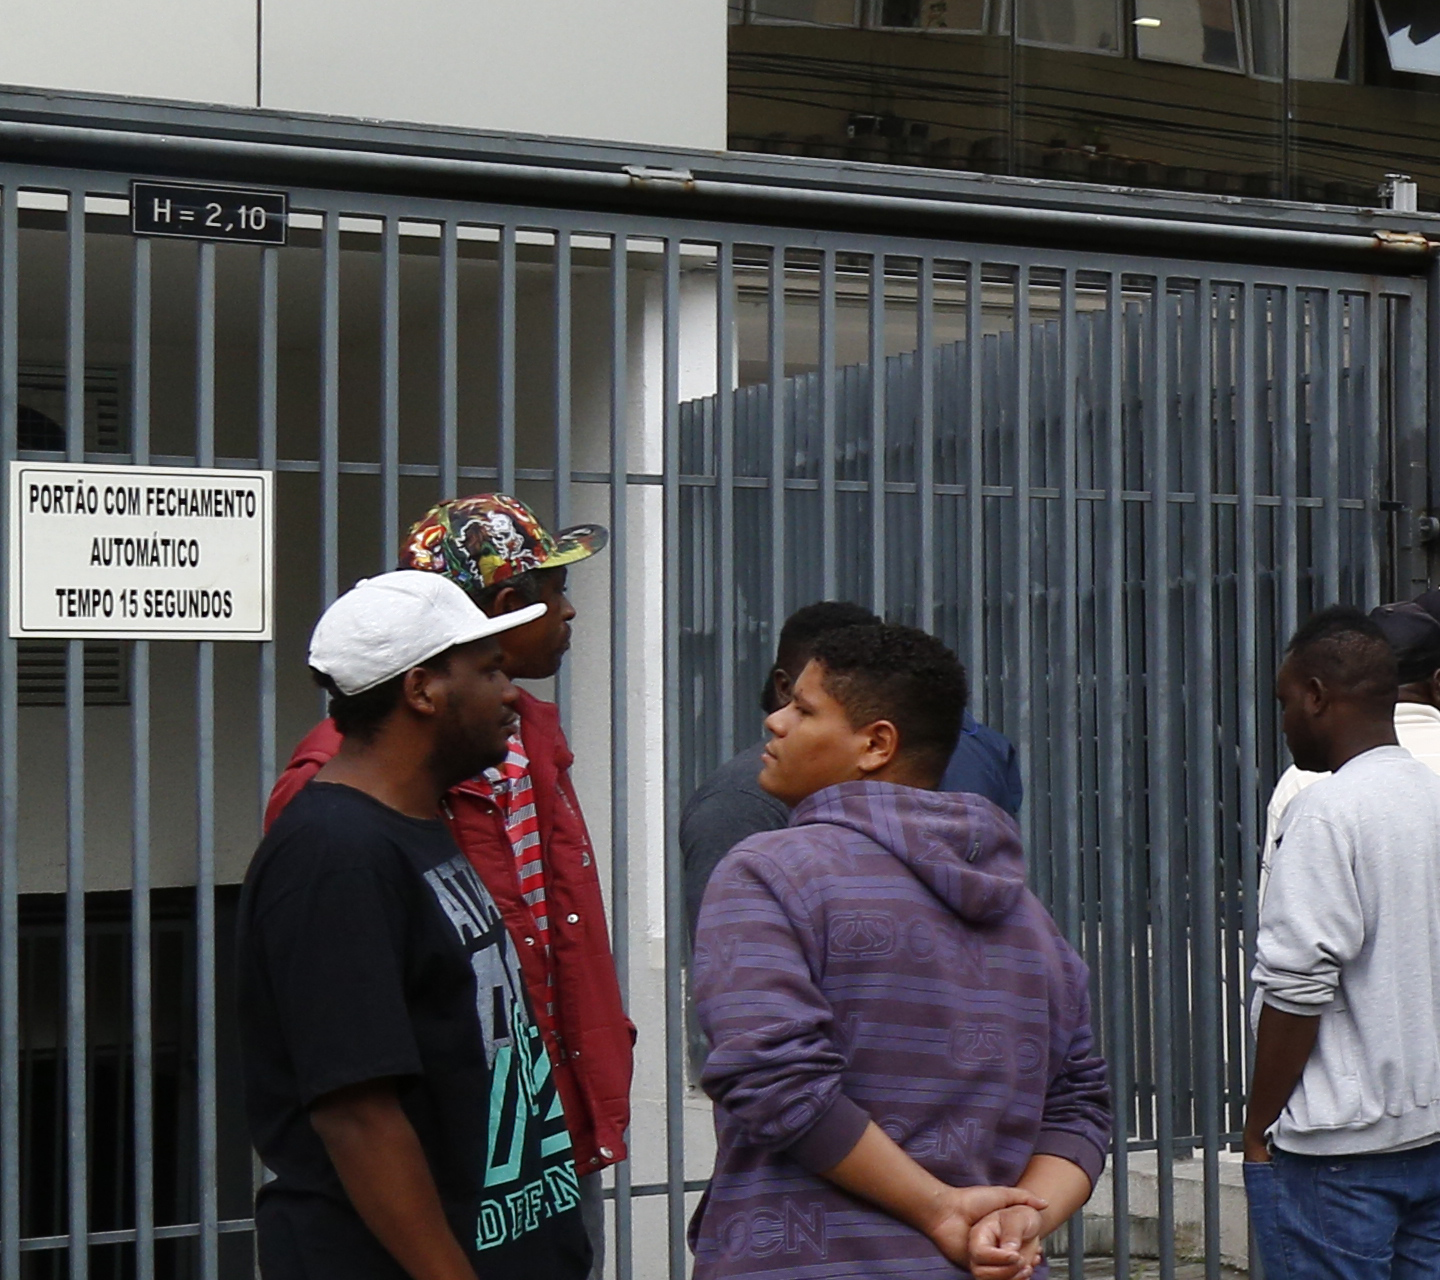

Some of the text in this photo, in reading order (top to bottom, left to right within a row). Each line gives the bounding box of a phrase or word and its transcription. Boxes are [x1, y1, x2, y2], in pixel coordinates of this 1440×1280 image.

[154, 198, 170, 223] H
[206, 202, 267, 231] 2,10
[29, 479, 257, 518] PORTÃO COM FECHAMENTO
[90, 531, 200, 568] AUTOMÁTICO
[56, 588, 233, 619] TEMPO 15 SEGUNDOS
